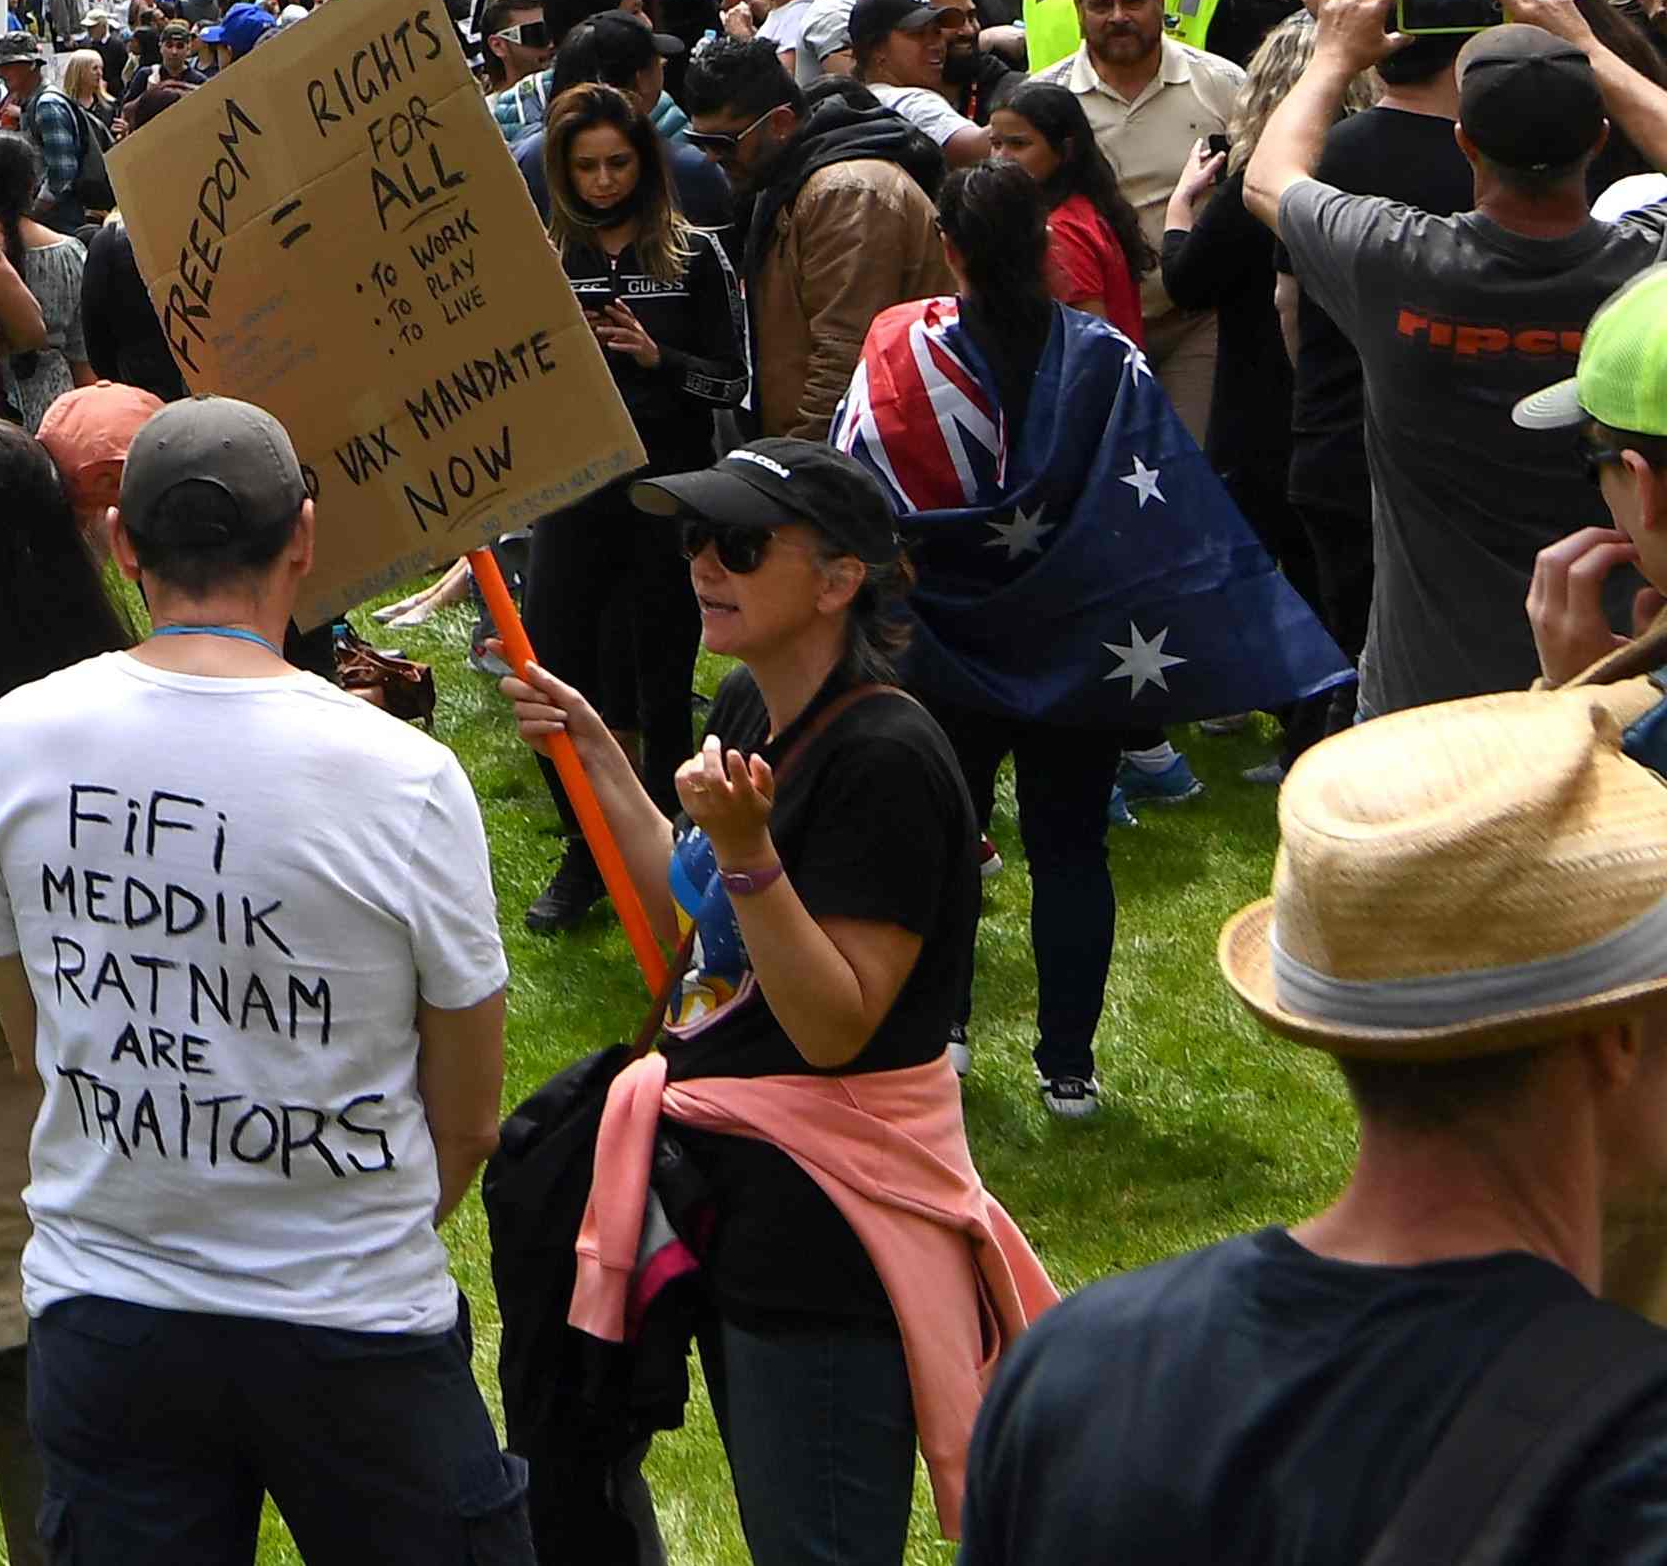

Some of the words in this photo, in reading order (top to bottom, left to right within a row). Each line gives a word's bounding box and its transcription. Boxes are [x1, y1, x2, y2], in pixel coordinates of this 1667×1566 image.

[306, 10, 442, 137] RIGHTS
[368, 95, 443, 162] FOR
[370, 143, 465, 231] ALL
[164, 98, 262, 374] FREEDOM
[371, 261, 398, 297] TO
[409, 209, 480, 273] WORK
[388, 297, 413, 323] TO
[426, 249, 476, 301] PLAY
[398, 322, 424, 347] TO
[441, 286, 487, 326] LIVE
[627, 279, 685, 294] GUESS
[333, 425, 401, 487] VAX
[404, 329, 556, 441] MANDATE
[403, 425, 513, 532] NOW
[42, 863, 295, 959] MEDDIK
[52, 935, 332, 1045] RATNAM
[110, 1022, 215, 1075] ARE
